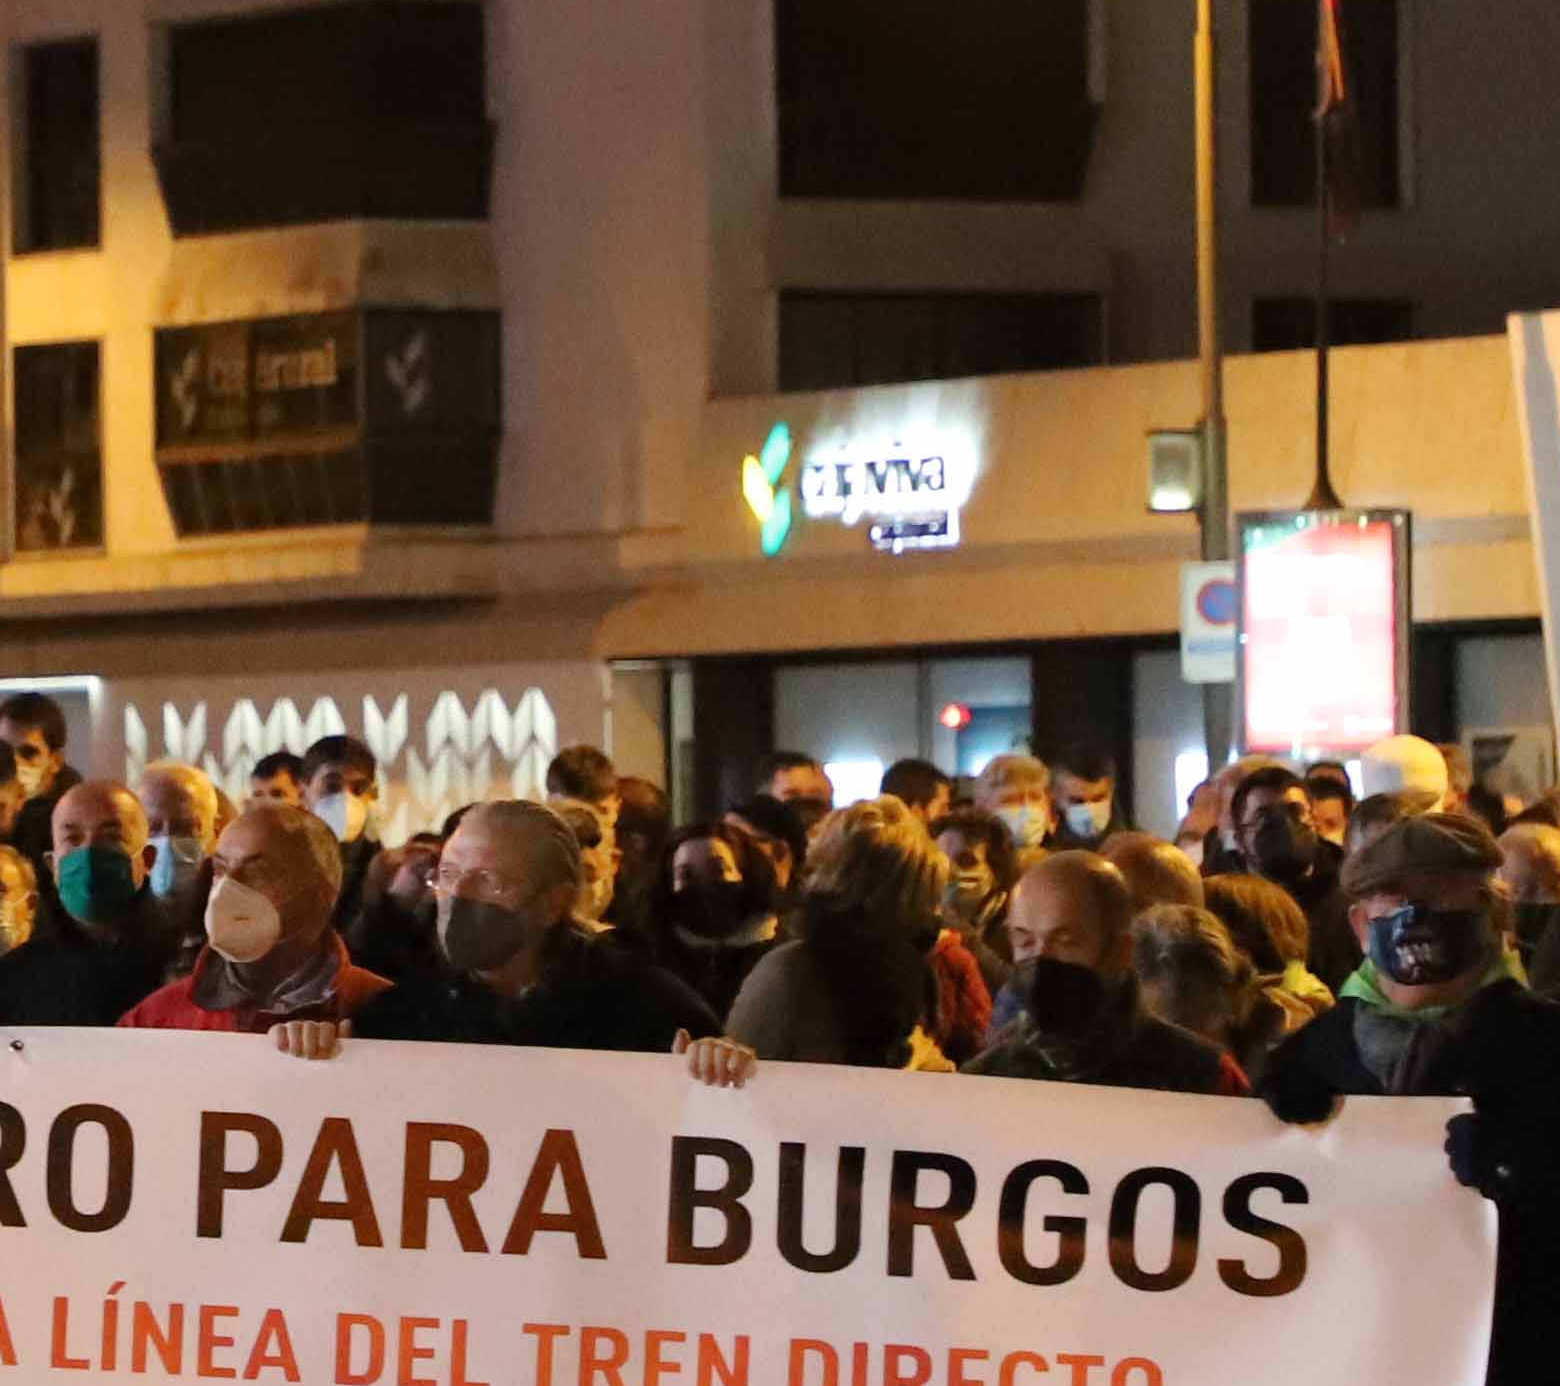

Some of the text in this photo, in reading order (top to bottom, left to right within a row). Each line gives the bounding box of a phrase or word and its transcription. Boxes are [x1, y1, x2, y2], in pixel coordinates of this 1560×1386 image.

[196, 1111, 608, 1260] PARA
[666, 1135, 1310, 1298] BURGOS
[51, 1281, 301, 1382] LÍNEA
